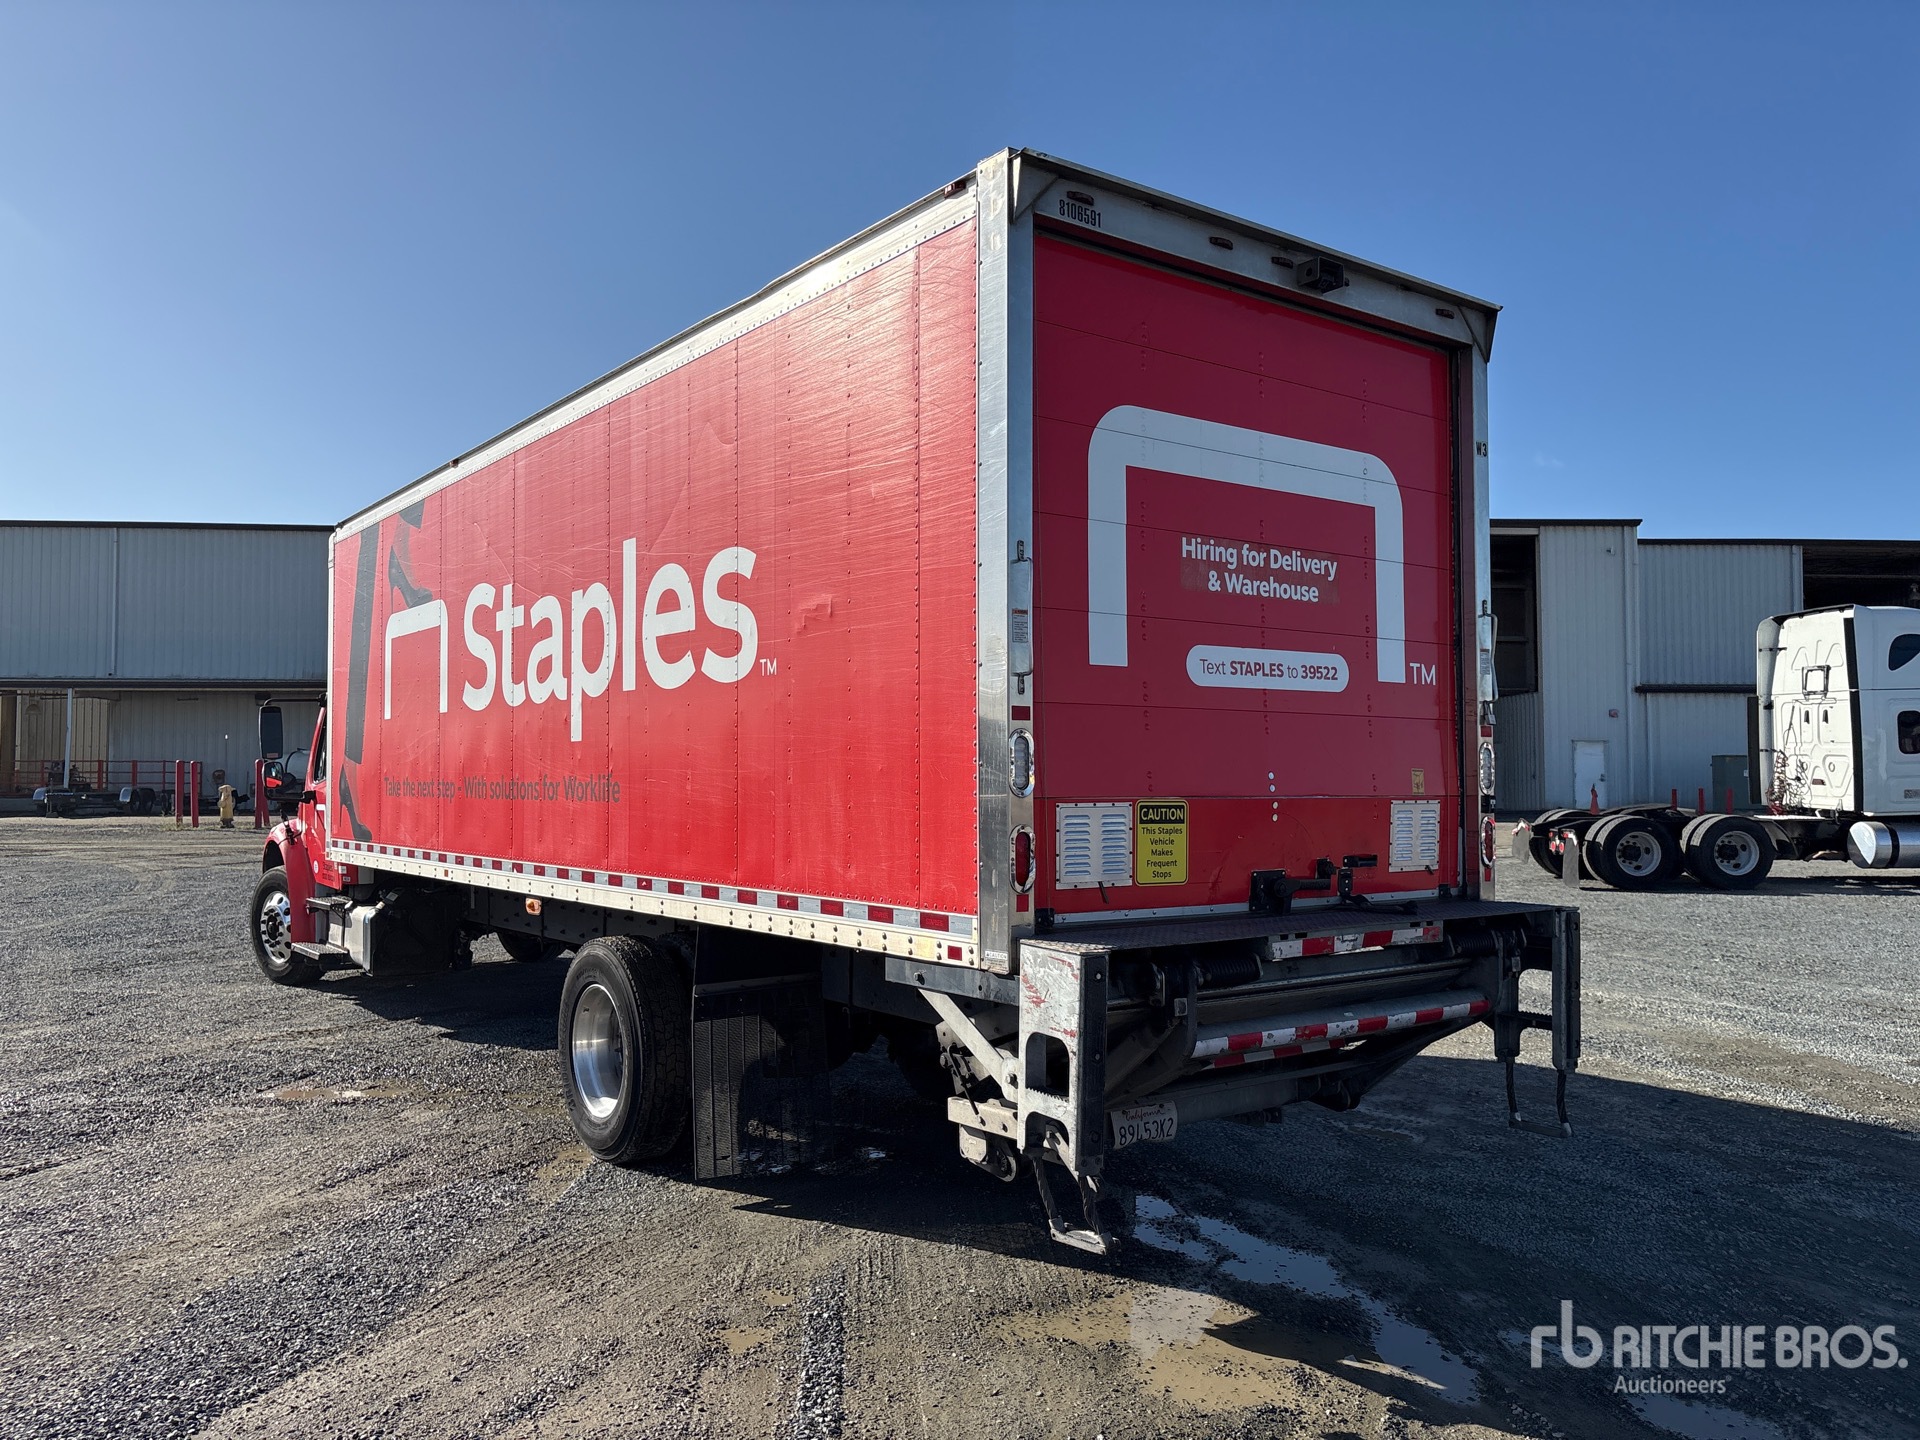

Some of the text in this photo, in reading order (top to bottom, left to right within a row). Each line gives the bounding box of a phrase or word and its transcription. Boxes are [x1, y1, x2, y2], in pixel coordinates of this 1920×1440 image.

[1059, 199, 1101, 228] 8106591
[1181, 536, 1338, 582] Hiring for Delivery
[1208, 570, 1319, 603] & Warehouse
[462, 537, 777, 742] Staples TM
[1199, 658, 1339, 681] Text STAPLES to 39522
[1409, 662, 1437, 686] TM
[384, 776, 401, 798] Take
[402, 777, 417, 798] the
[417, 779, 435, 798] next
[436, 778, 455, 803] step
[463, 775, 488, 799] With
[489, 774, 540, 801] solutions
[541, 773, 561, 801] for
[562, 772, 621, 803] Worklife
[1141, 808, 1184, 821] CAUTION
[1141, 826, 1183, 836] This Staples
[1149, 837, 1175, 846] Vehicle
[1151, 848, 1173, 857] Makes
[1146, 859, 1178, 869] Frequent
[1152, 870, 1172, 879] Stops
[1125, 1108, 1166, 1122] California
